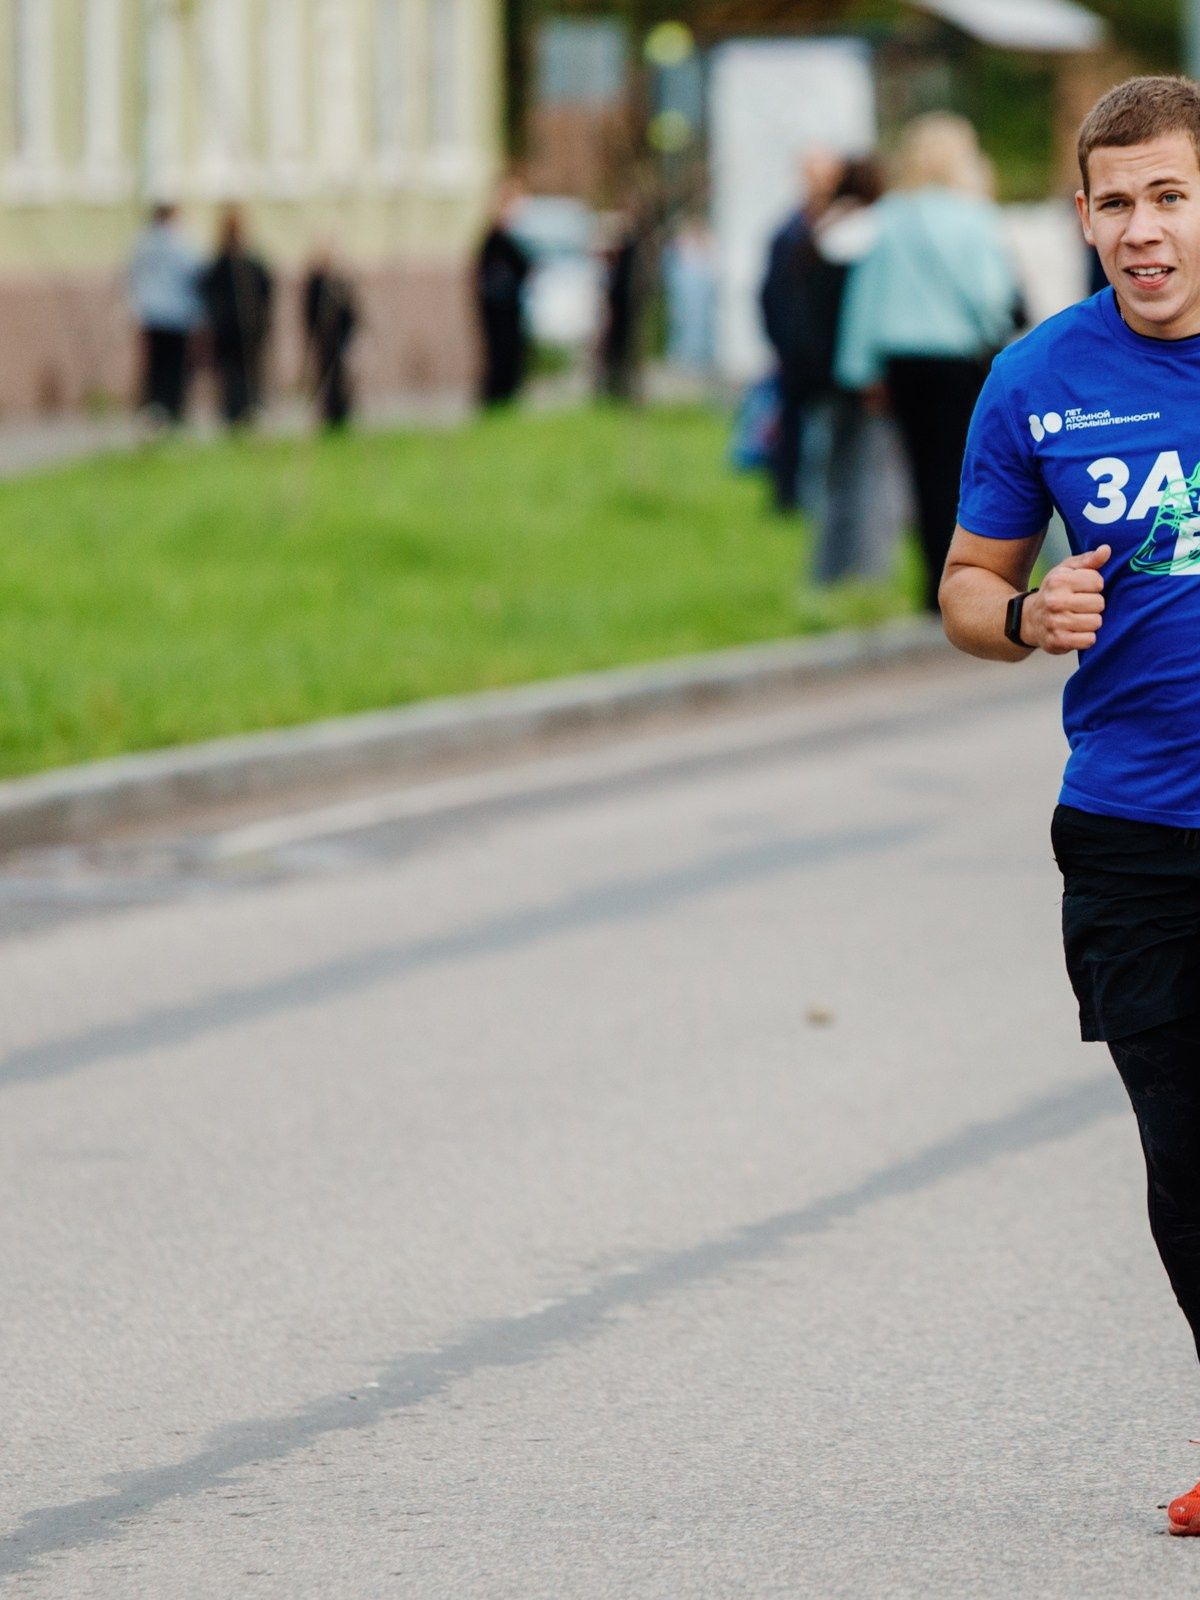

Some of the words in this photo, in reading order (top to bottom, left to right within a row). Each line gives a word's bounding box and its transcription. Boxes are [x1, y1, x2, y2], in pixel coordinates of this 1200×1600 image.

[1065, 408, 1082, 417] ЛЕТ
[1065, 410, 1111, 424] АТОМНОЙ
[1066, 412, 1160, 431] ПРОМЫШЛЕННОСТИ
